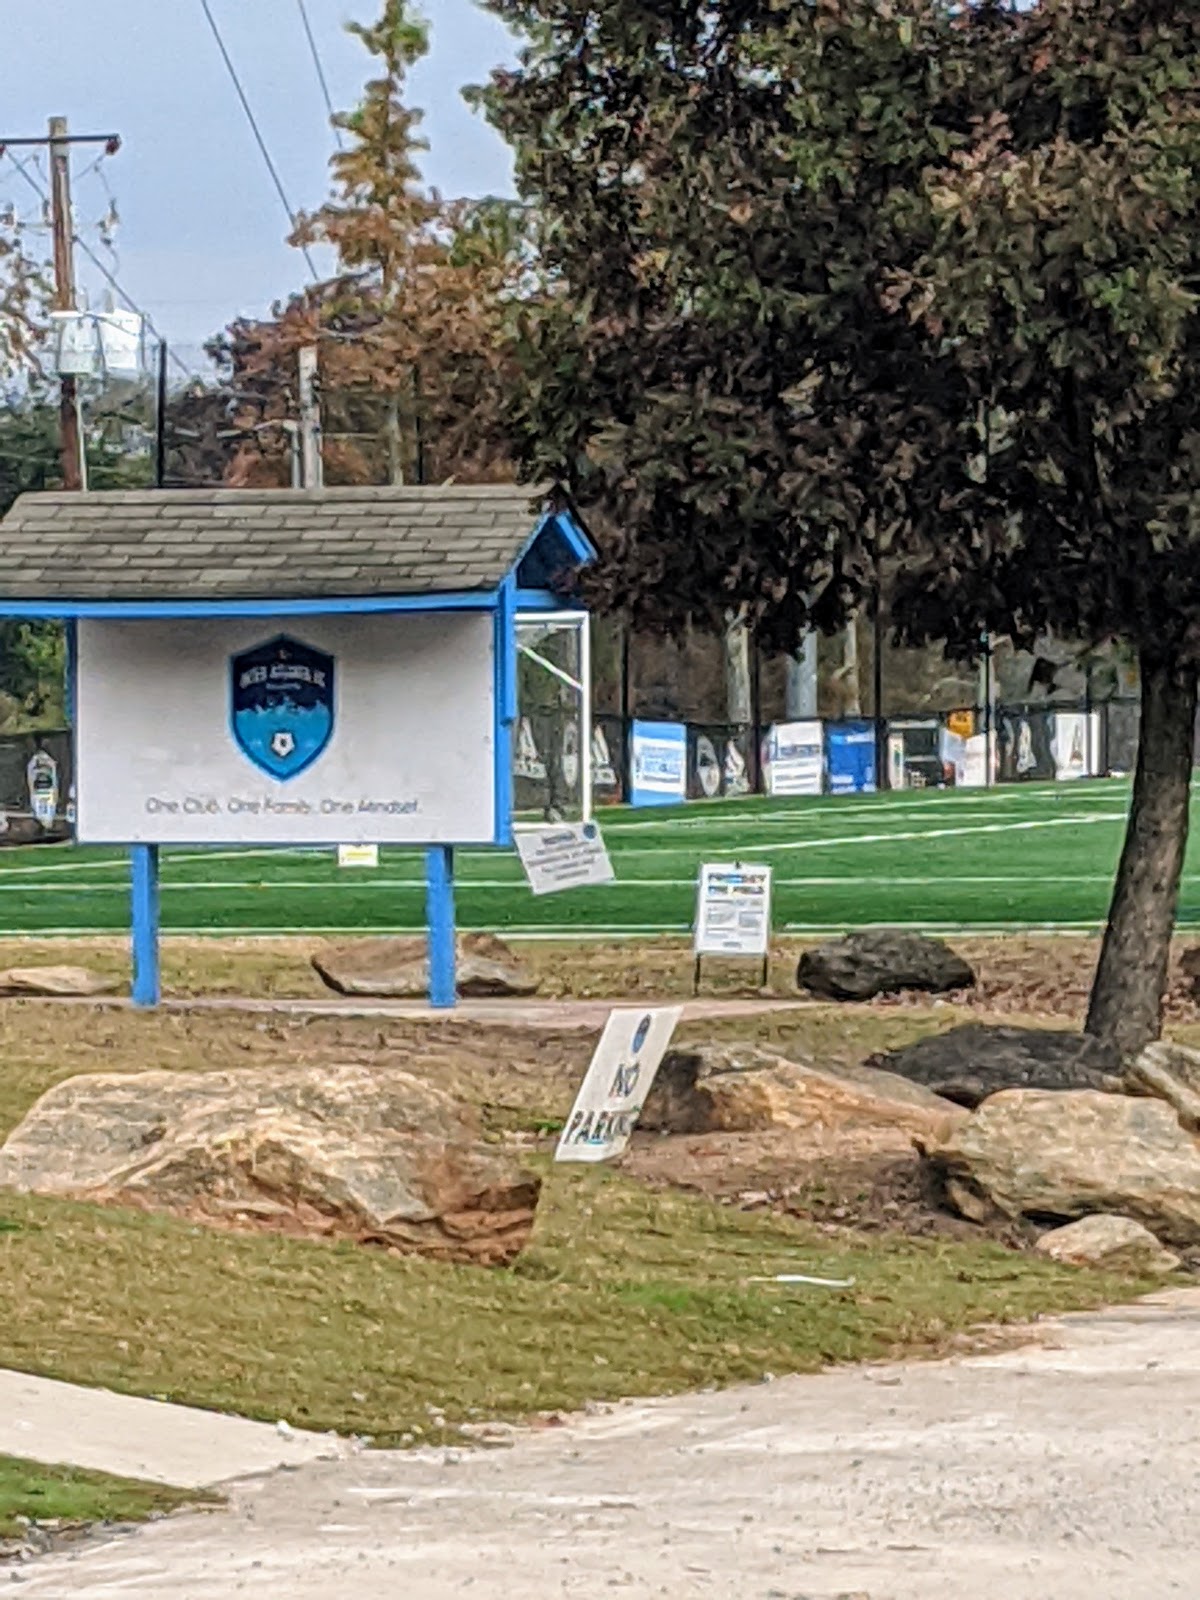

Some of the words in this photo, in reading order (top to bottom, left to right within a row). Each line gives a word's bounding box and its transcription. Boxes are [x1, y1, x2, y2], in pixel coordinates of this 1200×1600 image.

[146, 797, 179, 814] One
[227, 797, 260, 815] One
[320, 799, 354, 814] One
[609, 1062, 640, 1098] NO
